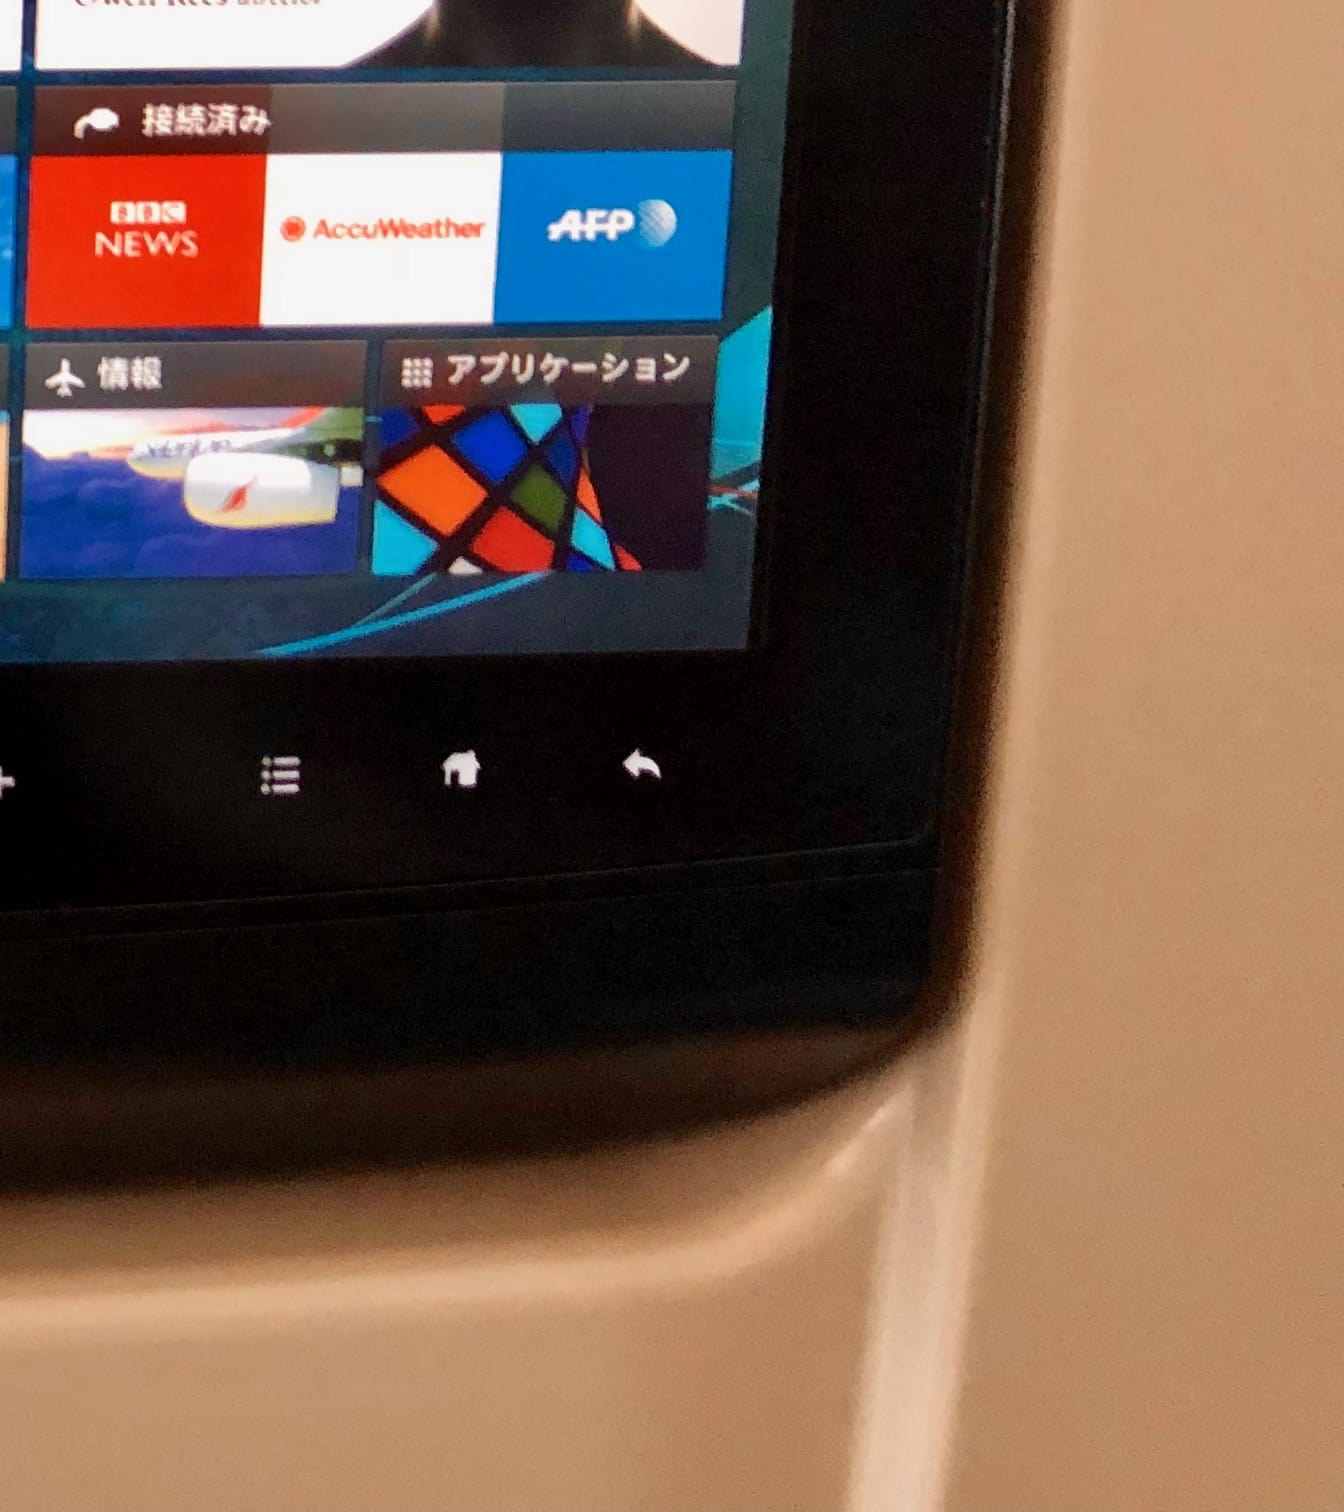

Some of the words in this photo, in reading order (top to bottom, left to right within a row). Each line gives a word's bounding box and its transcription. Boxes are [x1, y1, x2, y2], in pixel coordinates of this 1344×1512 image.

[141, 103, 272, 137] 接続済み
[110, 201, 187, 225] BBC
[546, 208, 636, 243] AFP
[95, 231, 199, 258] NEWS
[313, 217, 486, 242] AccuWeather
[97, 356, 164, 391] 情報
[447, 354, 690, 385] アプリケーション
